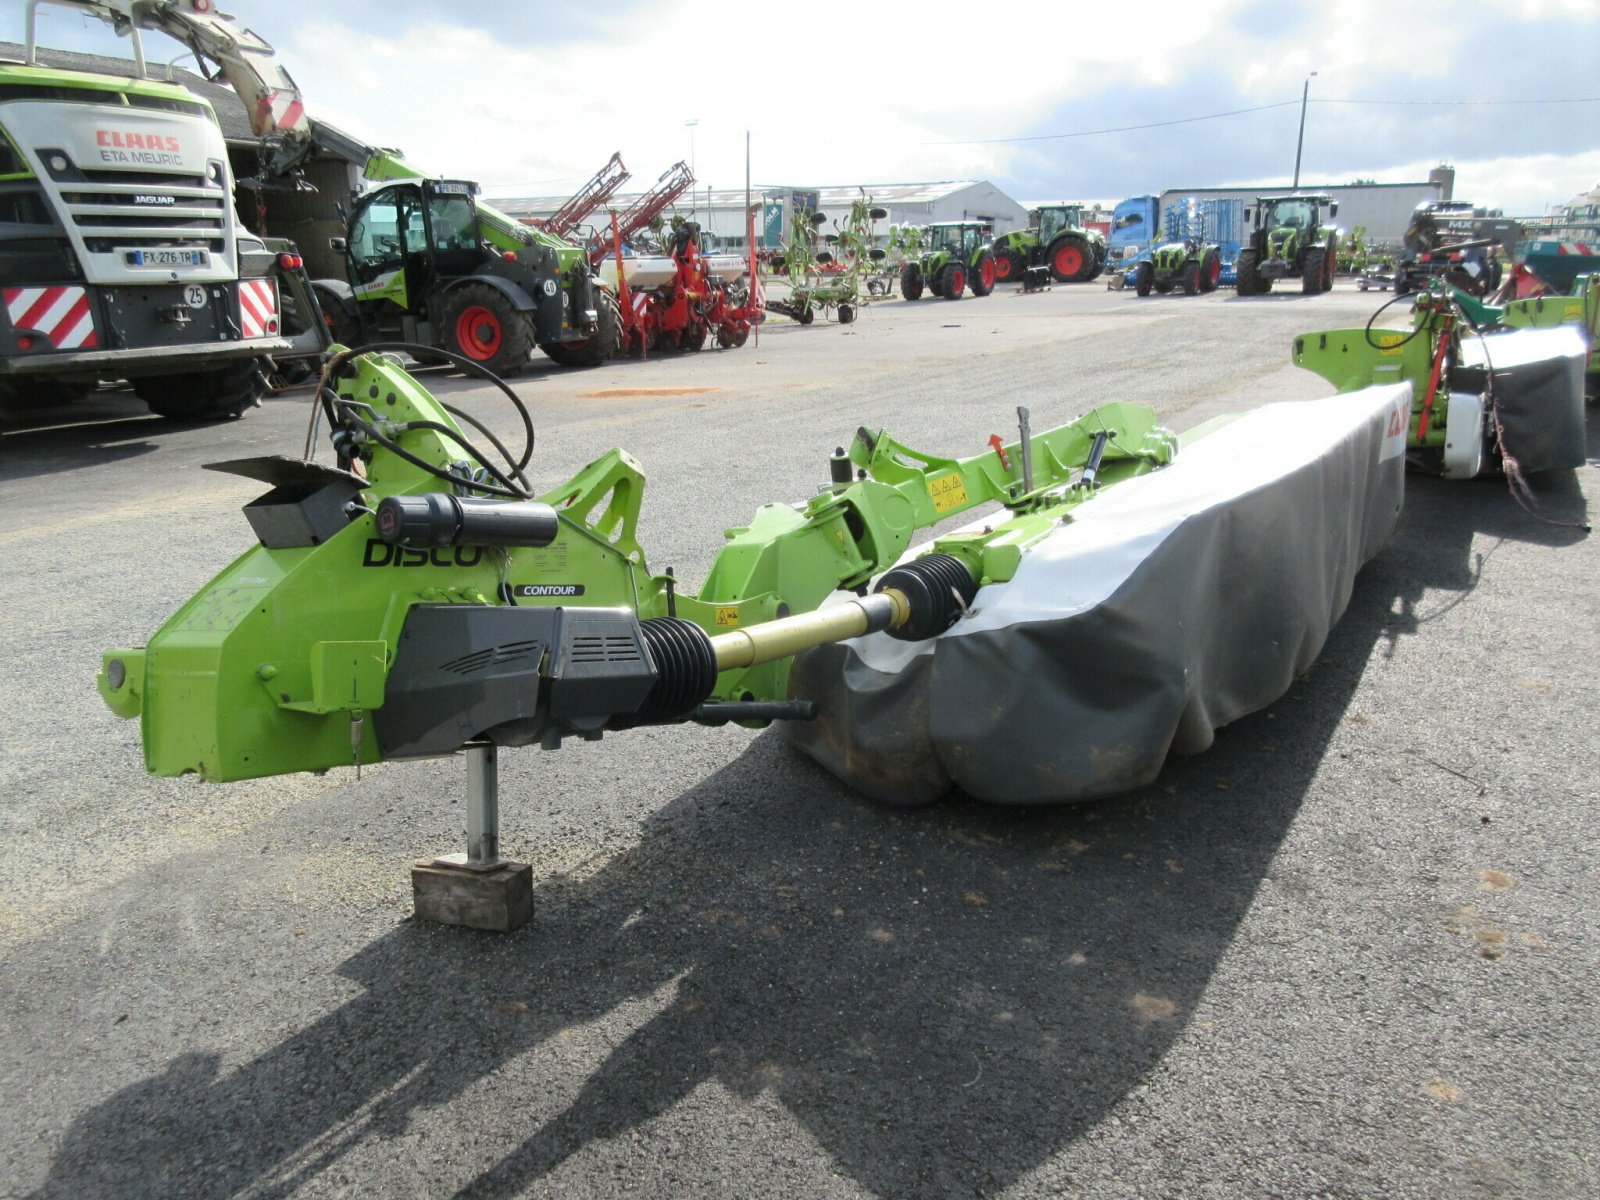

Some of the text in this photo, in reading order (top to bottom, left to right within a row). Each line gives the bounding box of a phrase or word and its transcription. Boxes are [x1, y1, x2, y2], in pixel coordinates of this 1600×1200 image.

[96, 130, 180, 152] CLAAS
[100, 150, 183, 166] ETA MEURIC
[134, 195, 175, 204] JAGUAR
[1449, 220, 1472, 229] MX
[143, 252, 192, 263] FX-276-TR
[545, 282, 555, 293] 40
[189, 287, 203, 304] 25
[363, 538, 482, 567] DISCO
[523, 586, 576, 595] CONTOUR
